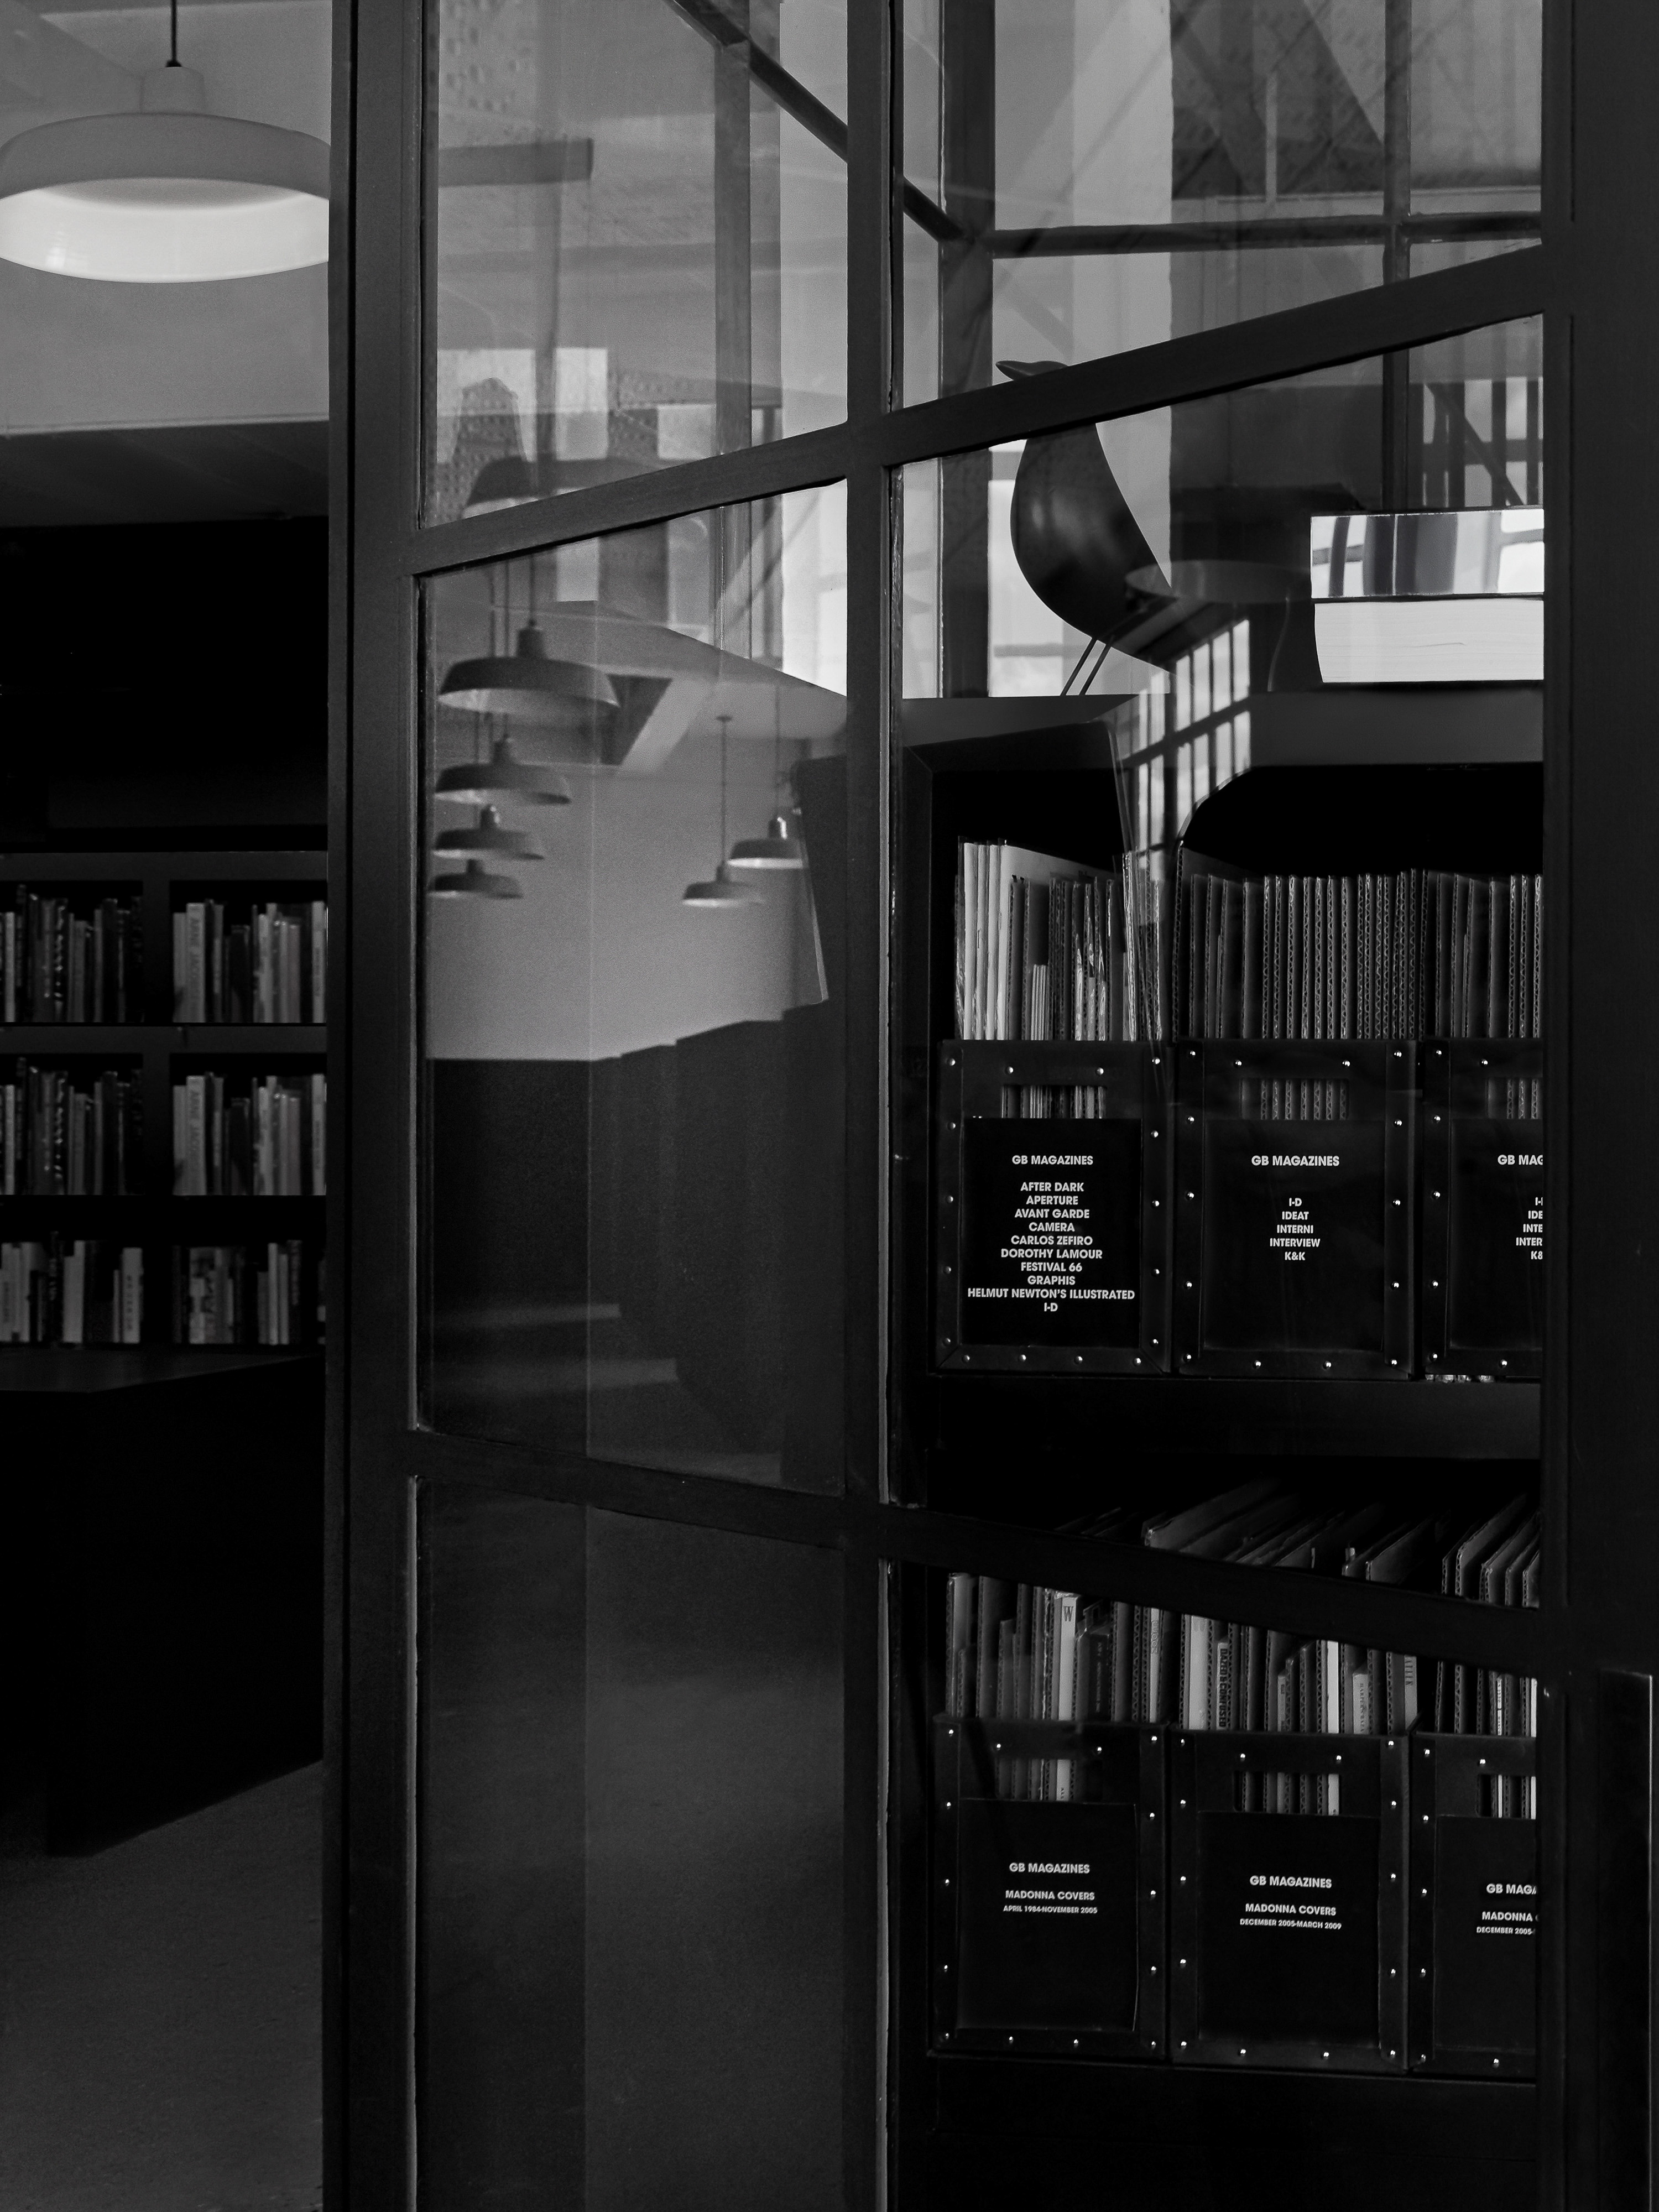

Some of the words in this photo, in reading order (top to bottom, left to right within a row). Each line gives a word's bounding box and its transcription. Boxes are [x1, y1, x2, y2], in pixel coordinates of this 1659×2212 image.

[1011, 1155, 1028, 1165] GB
[1031, 1155, 1093, 1165] MAGAZINES
[1251, 1155, 1269, 1166] GB
[1272, 1155, 1339, 1166] MAGAZINES
[1497, 1154, 1515, 1165] GB
[1020, 1182, 1052, 1192] AFTER
[1054, 1182, 1084, 1192] DARK
[1026, 1195, 1078, 1206] APERTURE
[1288, 1197, 1302, 1207] I-D
[1535, 1197, 1543, 1206] I-
[1014, 1208, 1050, 1218] AVANT
[1052, 1208, 1090, 1219] GARDE
[1282, 1211, 1310, 1220] IDEAT
[1029, 1222, 1075, 1232] CAMERA
[1276, 1224, 1314, 1234] INTERNI
[1522, 1223, 1543, 1233] INTE
[1010, 1235, 1055, 1245] CARLOS
[1056, 1235, 1093, 1246] ZEFIRO
[1270, 1238, 1321, 1248] INTERVIEW
[1516, 1237, 1543, 1246] INTER
[1001, 1248, 1054, 1259] DOROTHY
[1056, 1249, 1103, 1259] LAMOUR
[1284, 1251, 1306, 1261] K&K
[1021, 1261, 1067, 1272] FESTIVAL
[1068, 1262, 1083, 1272] 66
[1027, 1275, 1076, 1286] GRAPHIS
[968, 1287, 1009, 1298] HELMUT
[1011, 1288, 1067, 1299] NEWTON'S
[1070, 1289, 1135, 1300] ILLUSTRATED
[1044, 1302, 1058, 1312] I-D
[1009, 1862, 1026, 1872] GB
[1027, 1863, 1091, 1874] MAGAZINES
[1249, 1875, 1267, 1886] GB
[1269, 1876, 1332, 1888] MAGAZINES
[1486, 1883, 1504, 1894] GB
[1005, 1890, 1055, 1900] MADONNA
[1057, 1891, 1095, 1901] COVERS
[1245, 1903, 1297, 1914] MADONNA
[1298, 1905, 1337, 1916] COVERS
[1481, 1911, 1533, 1922] MADONNA
[1239, 1918, 1277, 1926] DECEMBER
[1278, 1919, 1323, 1929] 2005-MARCH
[1324, 1922, 1342, 1930] 2009
[1476, 1926, 1513, 1934] DECEMBER
[1514, 1927, 1536, 1936] 2005-
